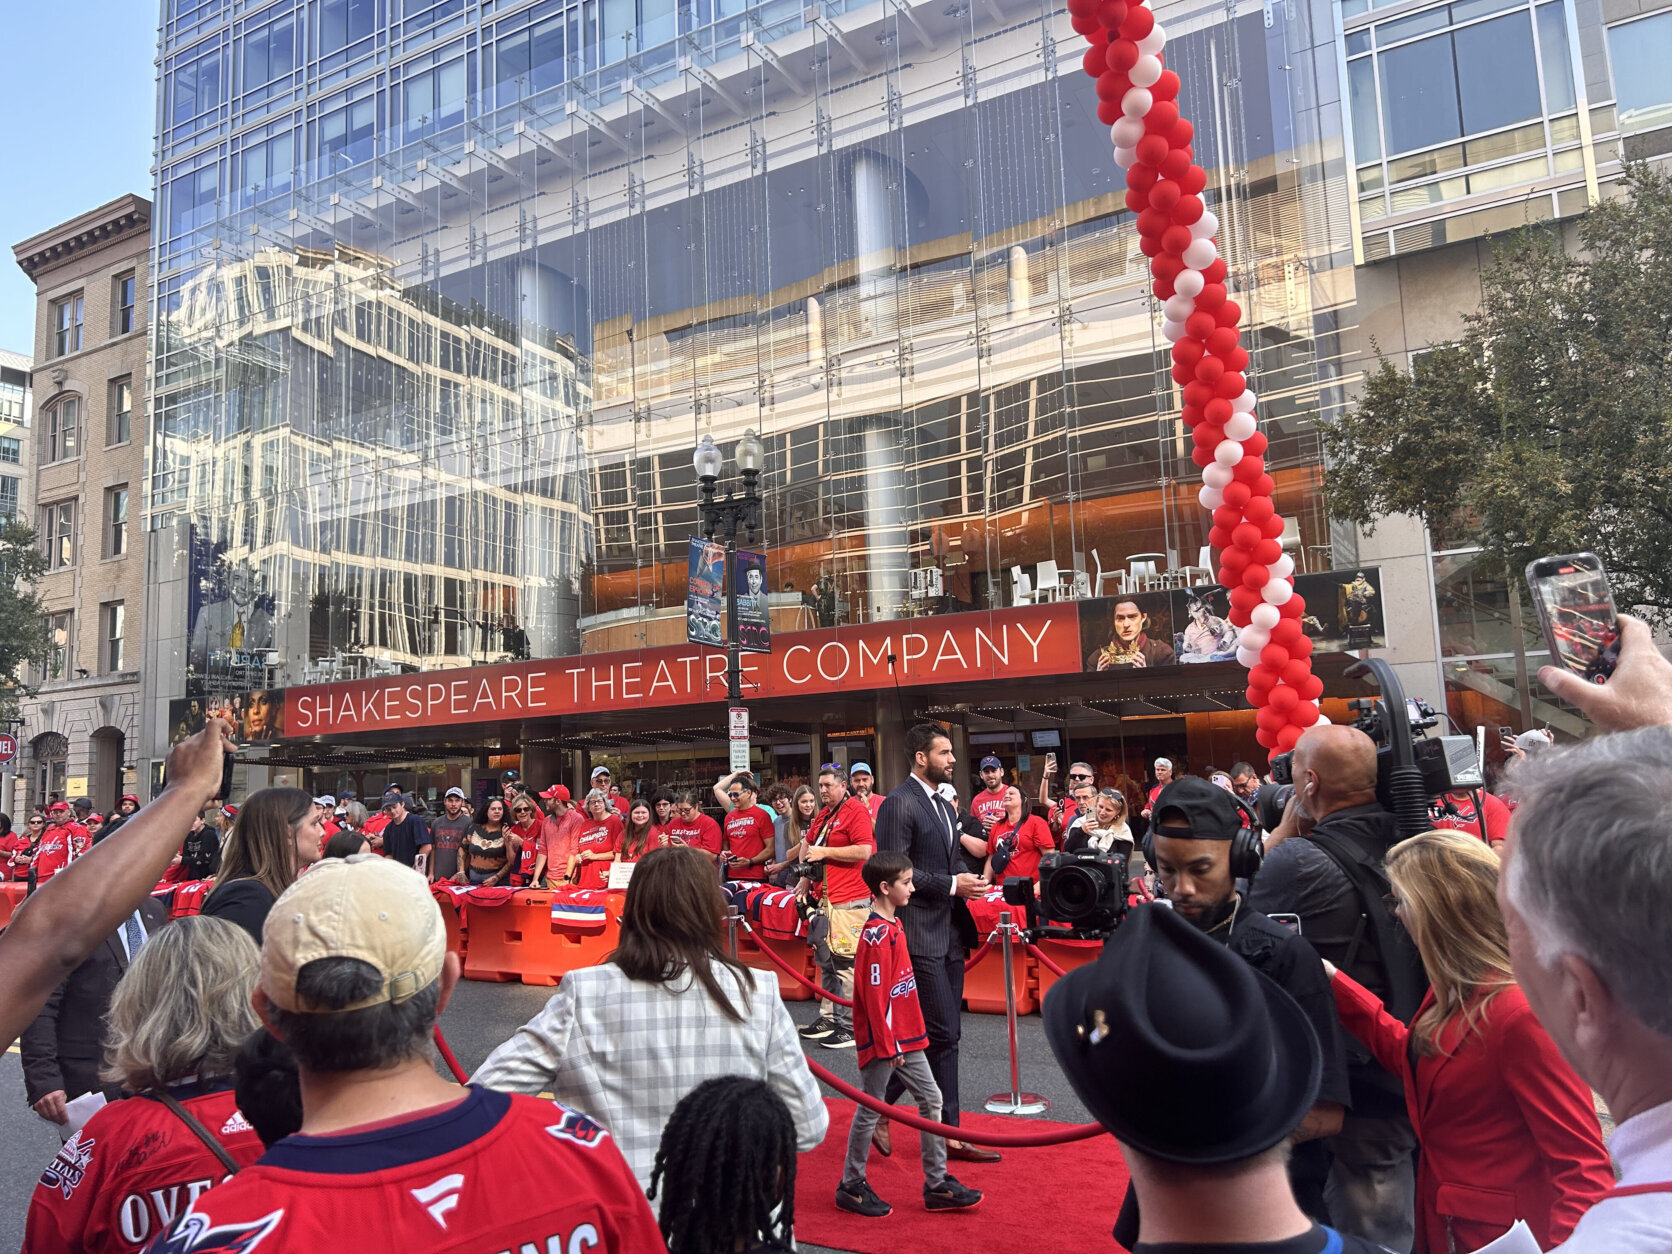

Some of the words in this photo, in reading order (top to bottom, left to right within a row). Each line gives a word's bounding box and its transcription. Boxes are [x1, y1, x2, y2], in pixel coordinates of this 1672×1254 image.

[297, 672, 547, 727] SHAKESPEARE
[565, 651, 760, 703] THEATRE
[783, 619, 1052, 684] COMPANY
[0, 741, 13, 754] EL
[978, 800, 1006, 814] CAPITAL
[870, 963, 881, 986] 8
[222, 1120, 254, 1134] adid
